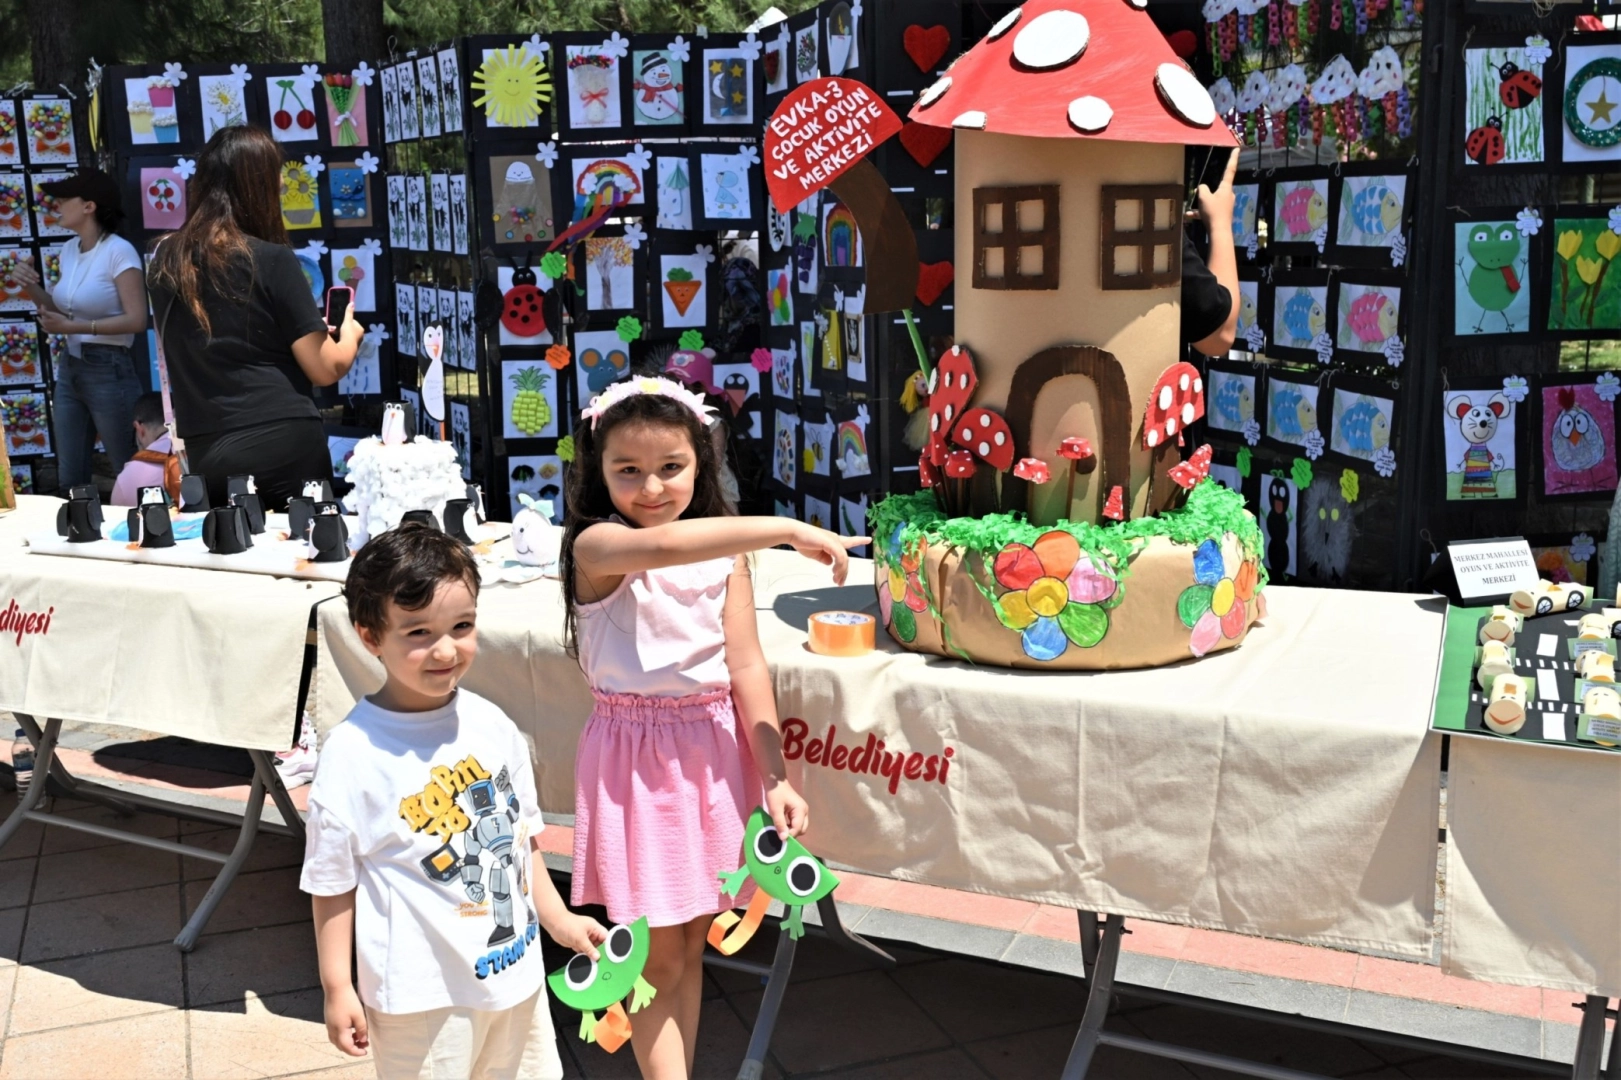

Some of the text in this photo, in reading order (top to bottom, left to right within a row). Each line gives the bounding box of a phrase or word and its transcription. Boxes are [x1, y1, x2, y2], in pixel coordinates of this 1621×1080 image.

[770, 80, 843, 138] EVKA-3
[771, 86, 870, 161] ÇOCUK OYUN
[772, 101, 882, 180] VE AKTİVİTE
[799, 128, 874, 191] MERKEZİ
[1453, 548, 1529, 563] MERKEZ MAHALLESİ
[1460, 559, 1530, 574] OYUN VE AKTİVİTE
[1482, 573, 1516, 585] MERKEZİ
[781, 717, 955, 795] Belediyesi
[525, 923, 540, 946] OU
